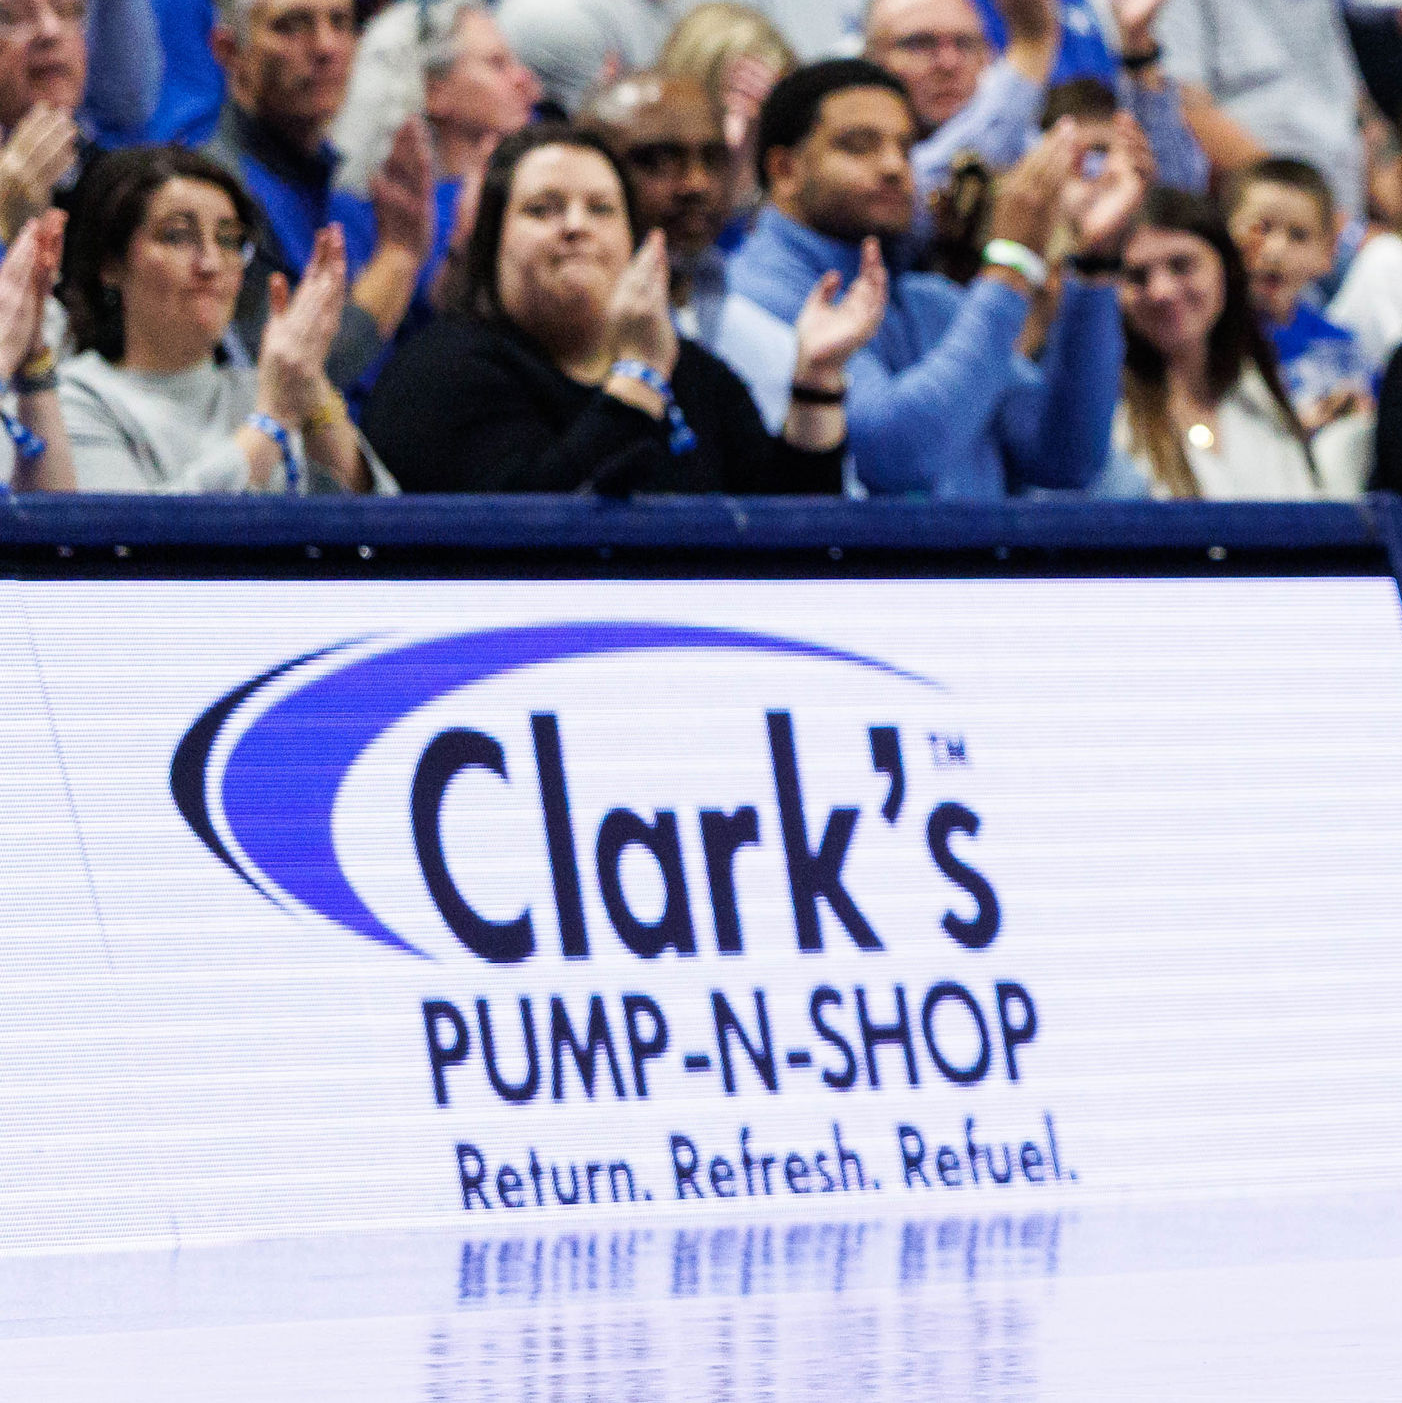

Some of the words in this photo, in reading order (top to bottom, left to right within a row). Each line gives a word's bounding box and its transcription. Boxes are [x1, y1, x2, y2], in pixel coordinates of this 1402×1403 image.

[410, 709, 1002, 964] Clark's
[421, 980, 1040, 1108] PUMP-N-SHOP
[456, 1141, 653, 1210] Return.
[669, 1117, 881, 1200] Refresh.
[896, 1109, 1079, 1190] Refuel.
